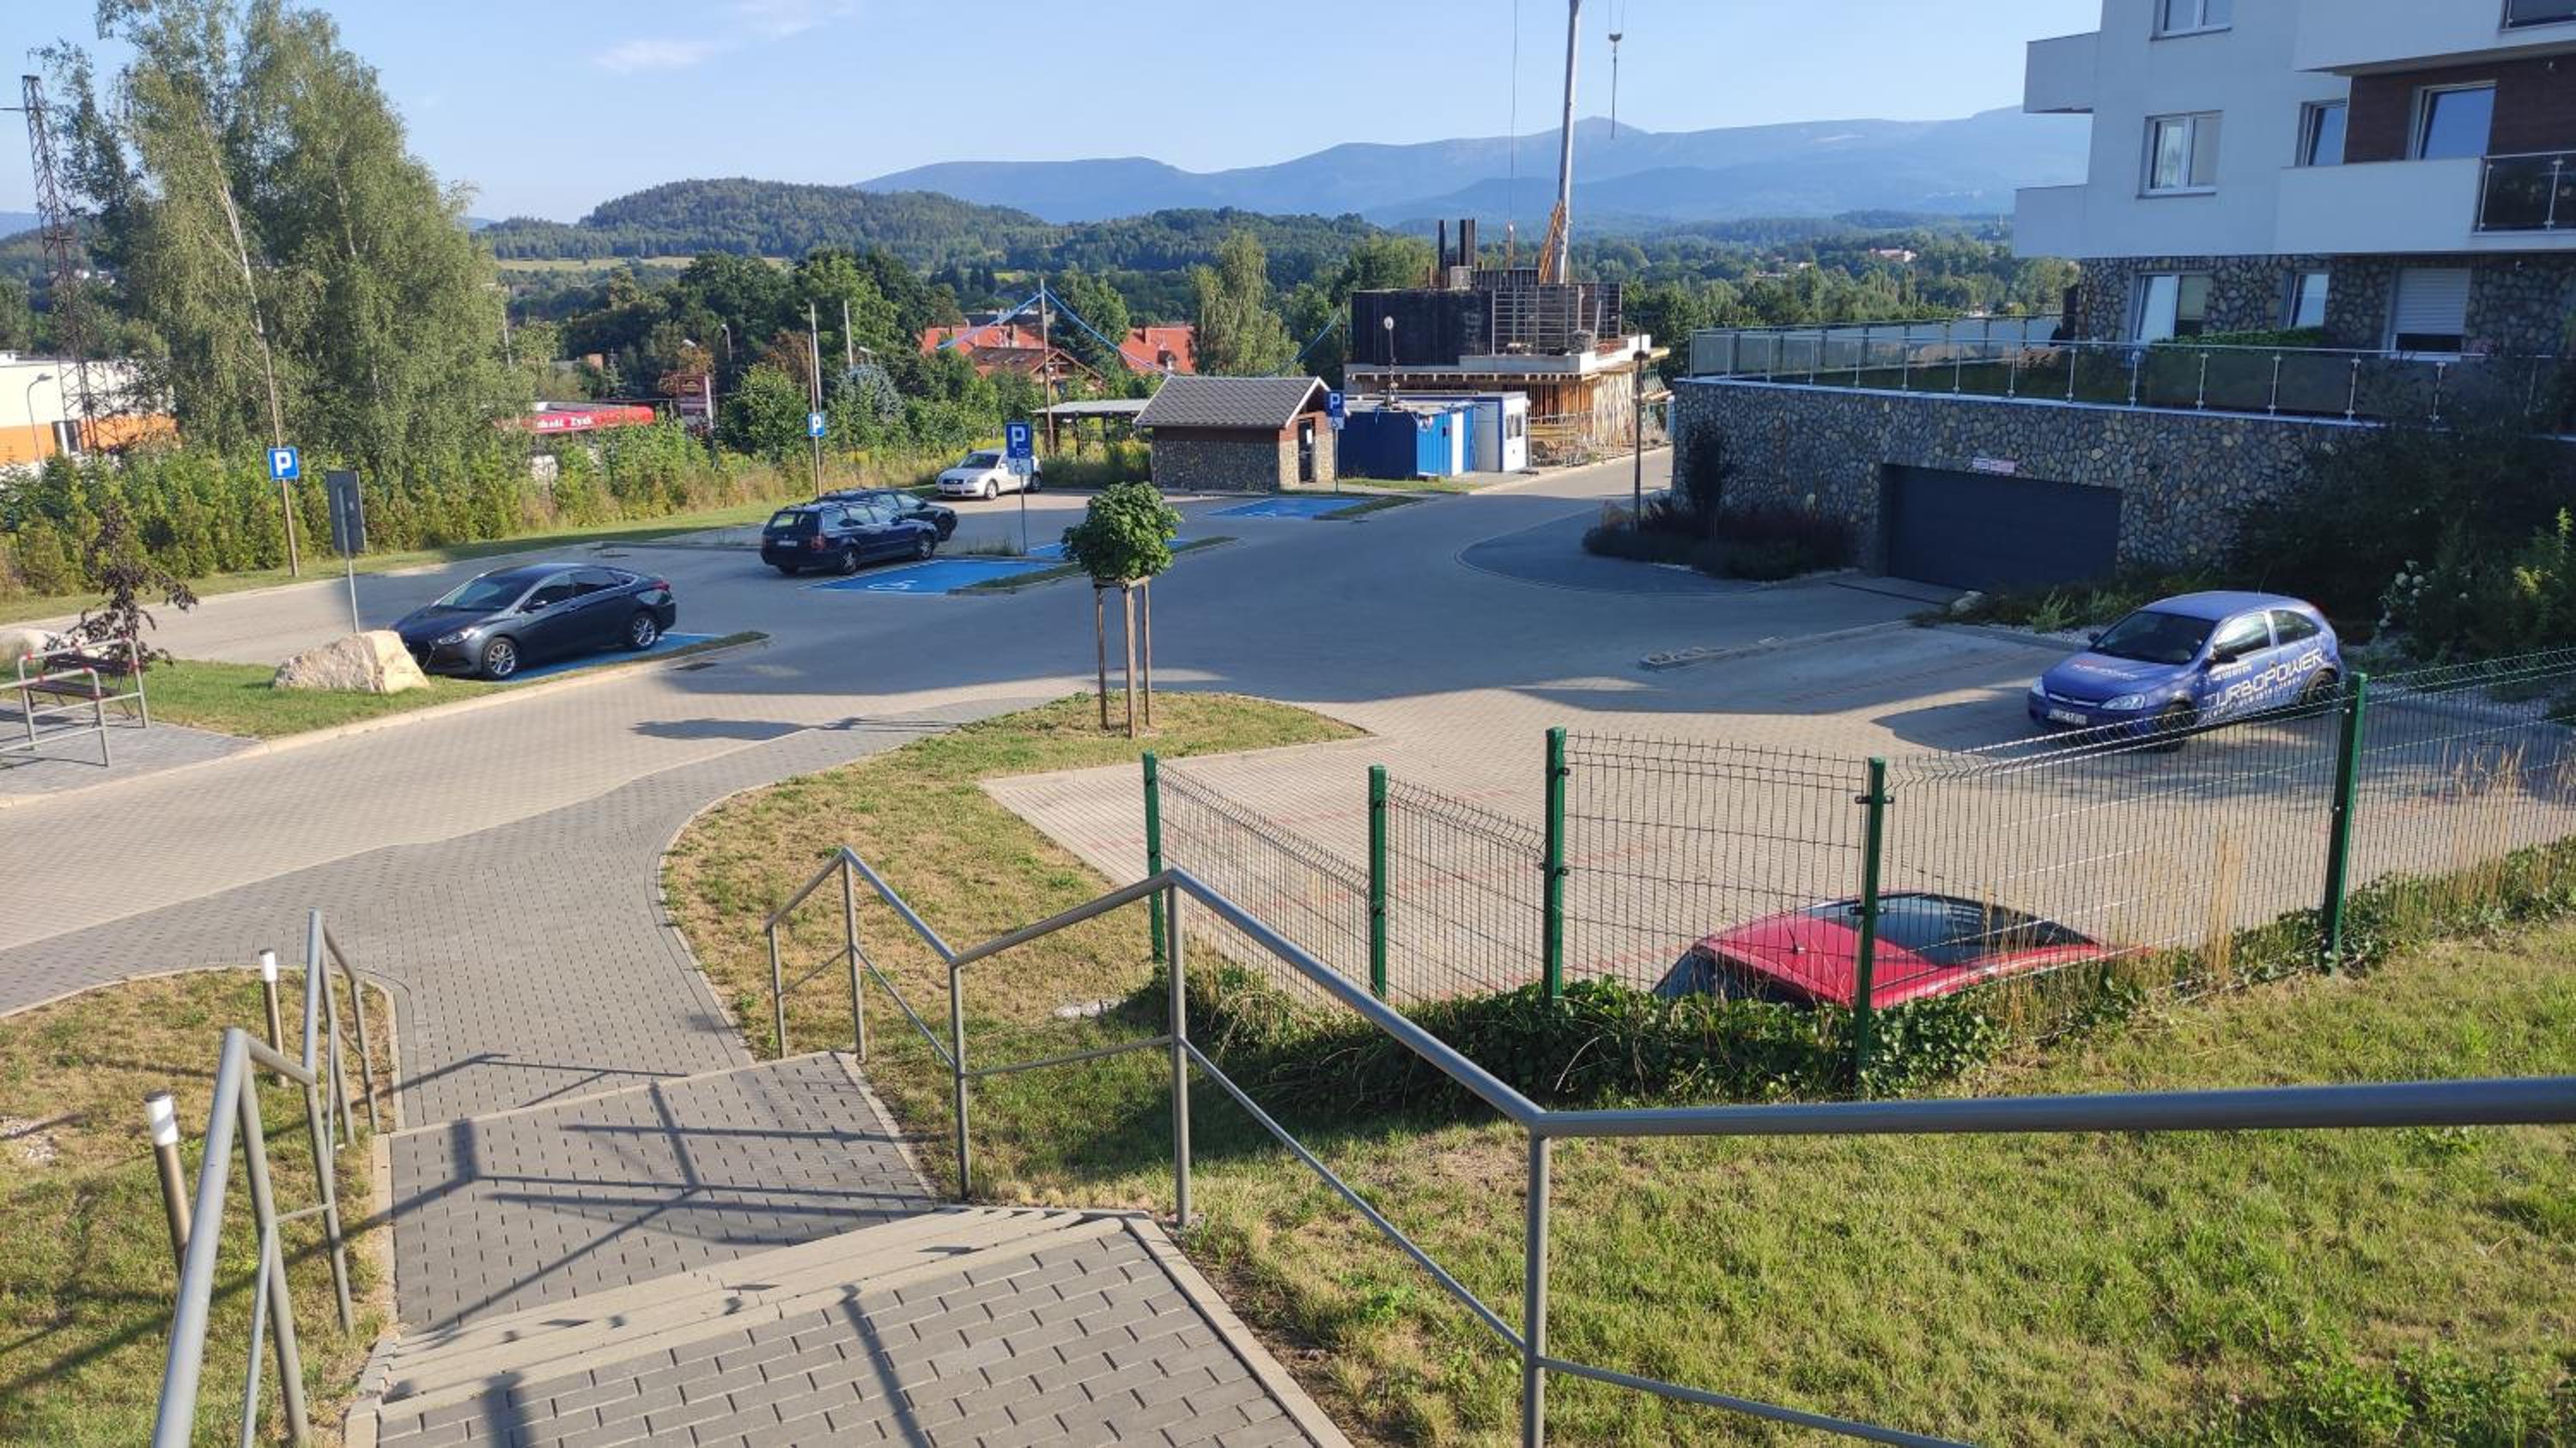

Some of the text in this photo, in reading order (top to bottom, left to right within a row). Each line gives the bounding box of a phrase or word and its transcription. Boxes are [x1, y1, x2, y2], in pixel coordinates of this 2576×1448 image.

[1329, 392, 1340, 410] P
[812, 415, 822, 434] P
[1011, 426, 1026, 448] P
[275, 452, 293, 476] P
[2203, 648, 2324, 708] TURBOPOWER
